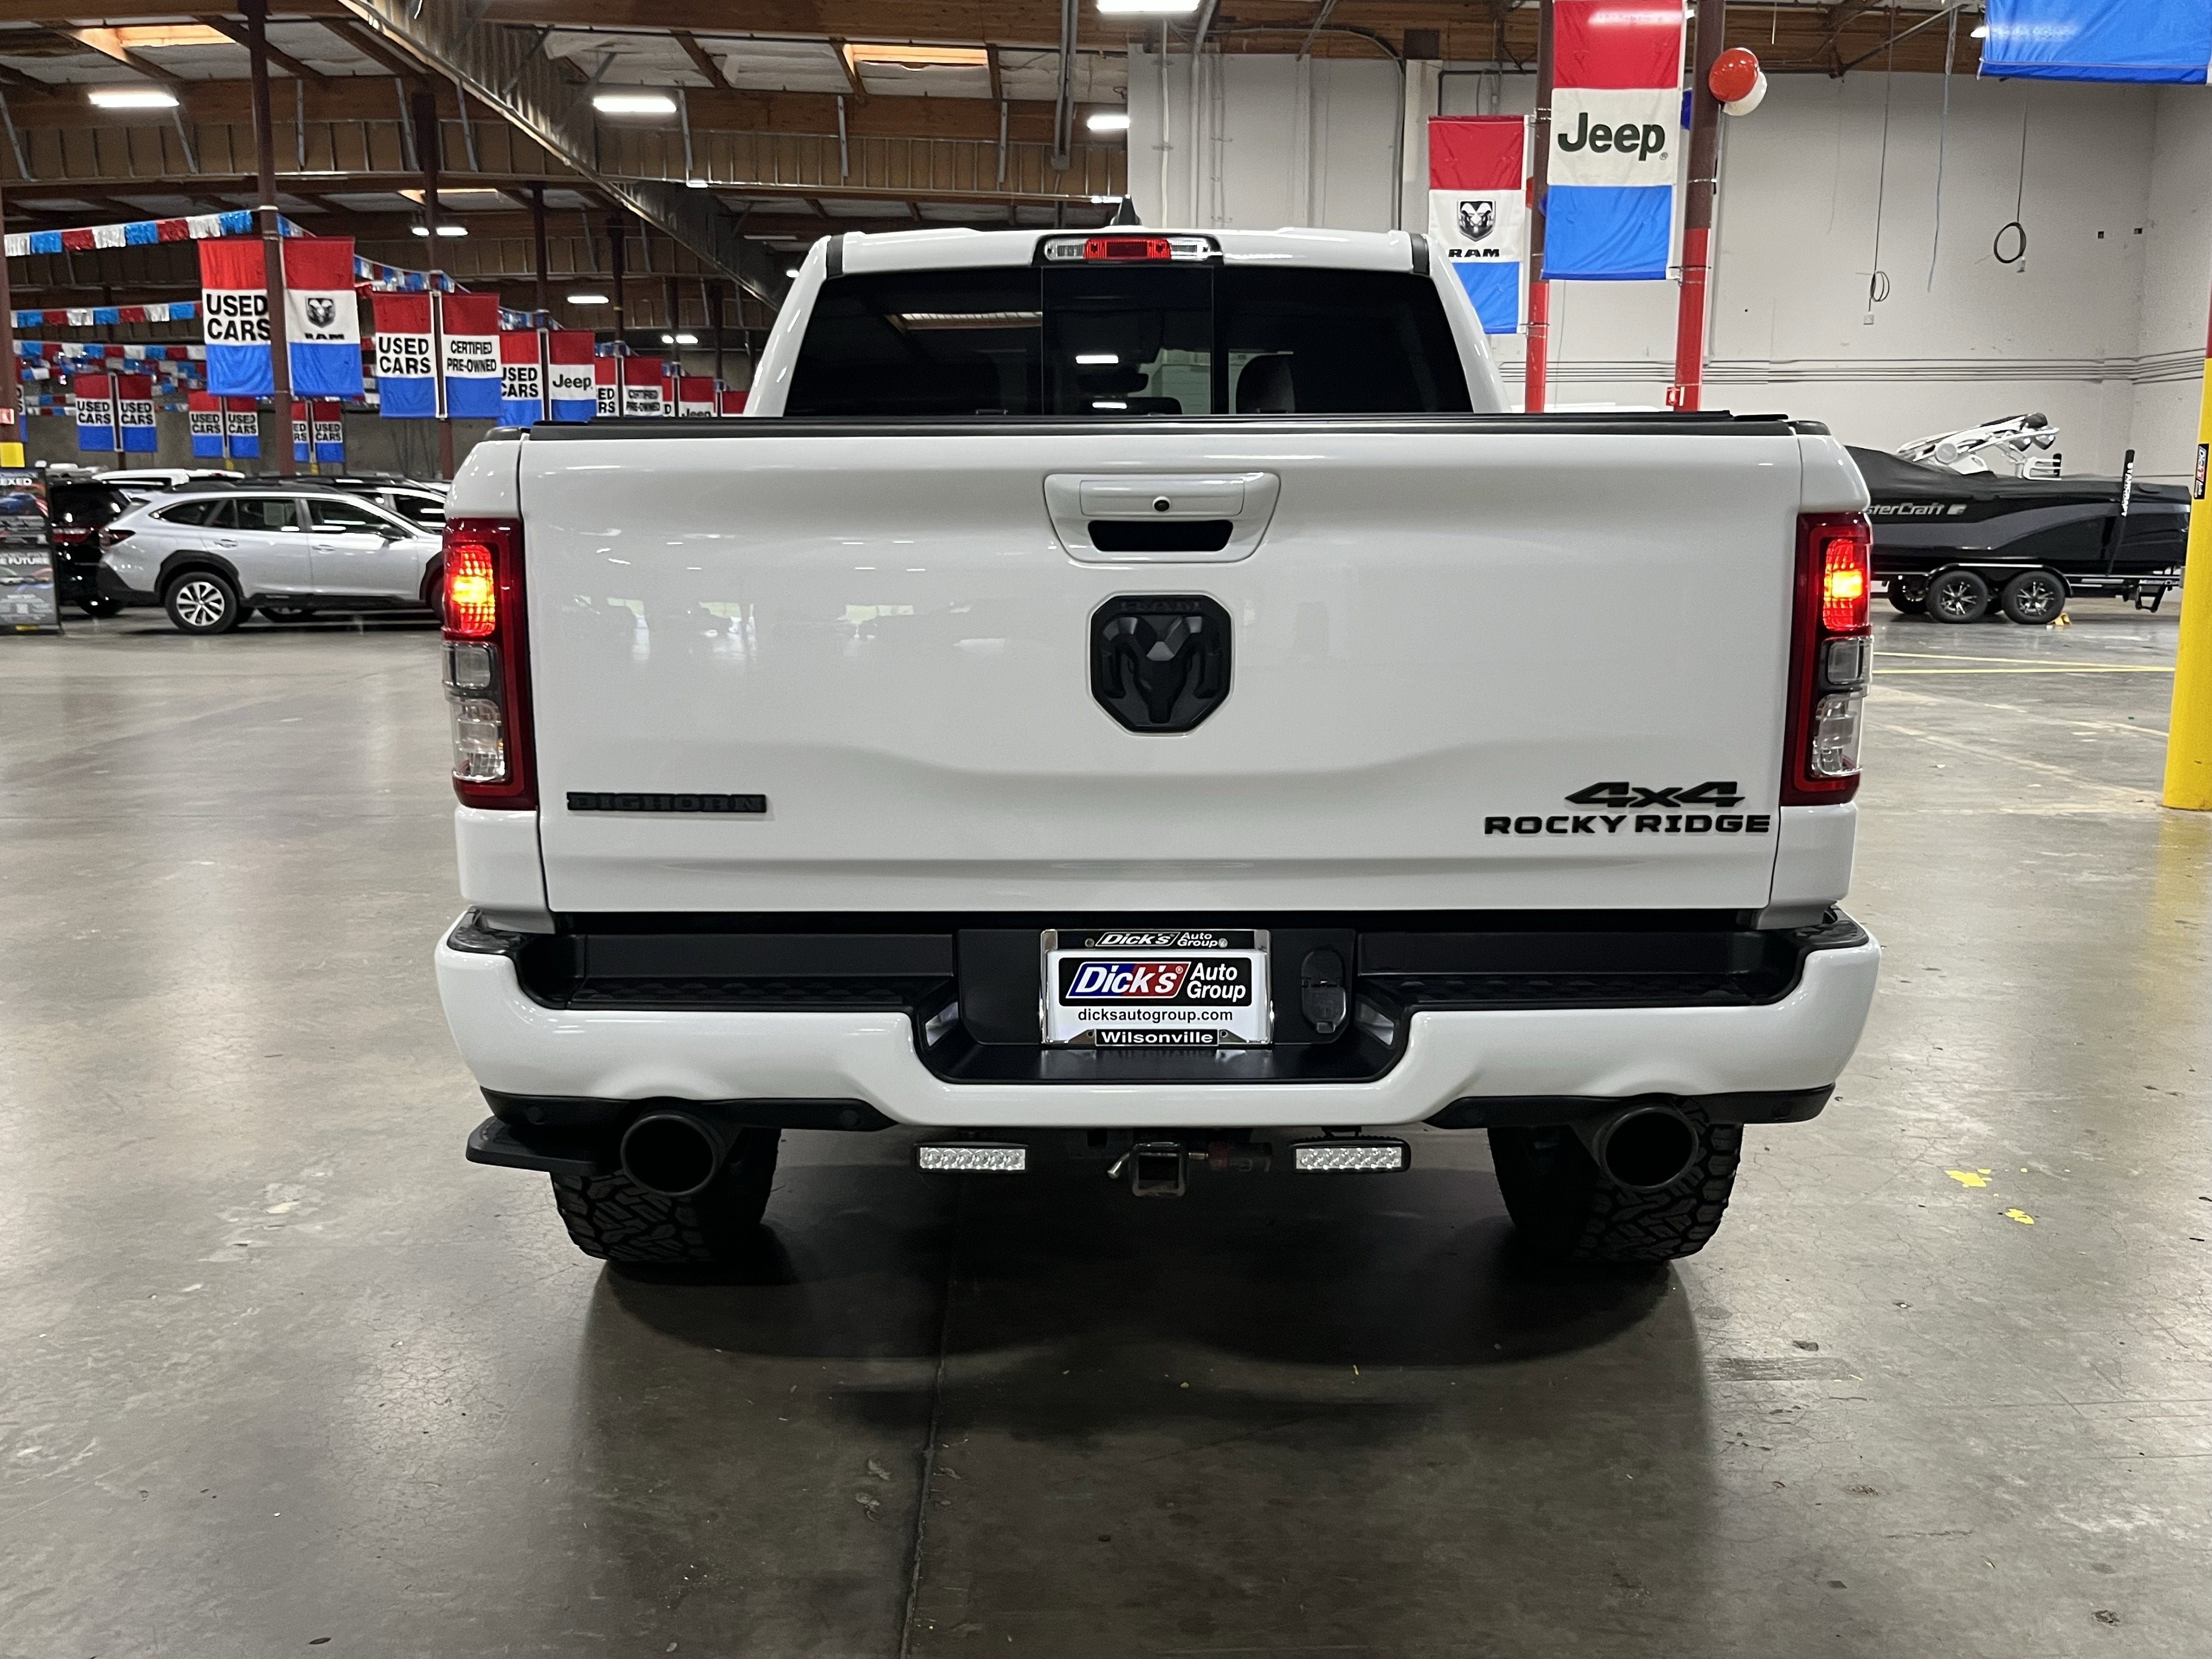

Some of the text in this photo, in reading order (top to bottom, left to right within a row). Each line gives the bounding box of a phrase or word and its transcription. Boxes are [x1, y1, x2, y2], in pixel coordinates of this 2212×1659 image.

[1558, 112, 1665, 161] Jeep
[1448, 249, 1500, 257] RAM
[206, 294, 268, 317] USED
[207, 318, 270, 341] CARS
[379, 336, 429, 355] USED
[450, 340, 492, 354] CERTIFIED
[380, 356, 431, 374] CARS
[447, 358, 496, 373] PRE-OWNED
[552, 374, 592, 391] Jeep
[598, 388, 614, 400] ED
[77, 401, 110, 411] USED
[121, 403, 152, 412] USED
[599, 402, 616, 413] RS
[78, 414, 111, 424] CARS
[121, 414, 154, 425] CARS
[192, 414, 220, 422] USED
[228, 414, 255, 423] USED
[193, 424, 221, 433] CARS
[228, 424, 257, 434] CARS
[294, 423, 306, 432] ED
[315, 424, 340, 432] USED
[294, 433, 307, 441] RS
[316, 433, 341, 441] CARS
[1866, 503, 1945, 515] sterCraft
[1565, 781, 1745, 808] 4x4
[1485, 814, 1770, 834] ROCKY RIDGE
[1101, 933, 1171, 945] Dick's
[1177, 939, 1218, 948] Group
[1190, 963, 1238, 980] Auto
[1075, 965, 1177, 993] Dick's
[1187, 981, 1246, 1002] Group
[1078, 1008, 1233, 1024] dicksautogroup.com
[1101, 1031, 1213, 1043] Wilsonville
